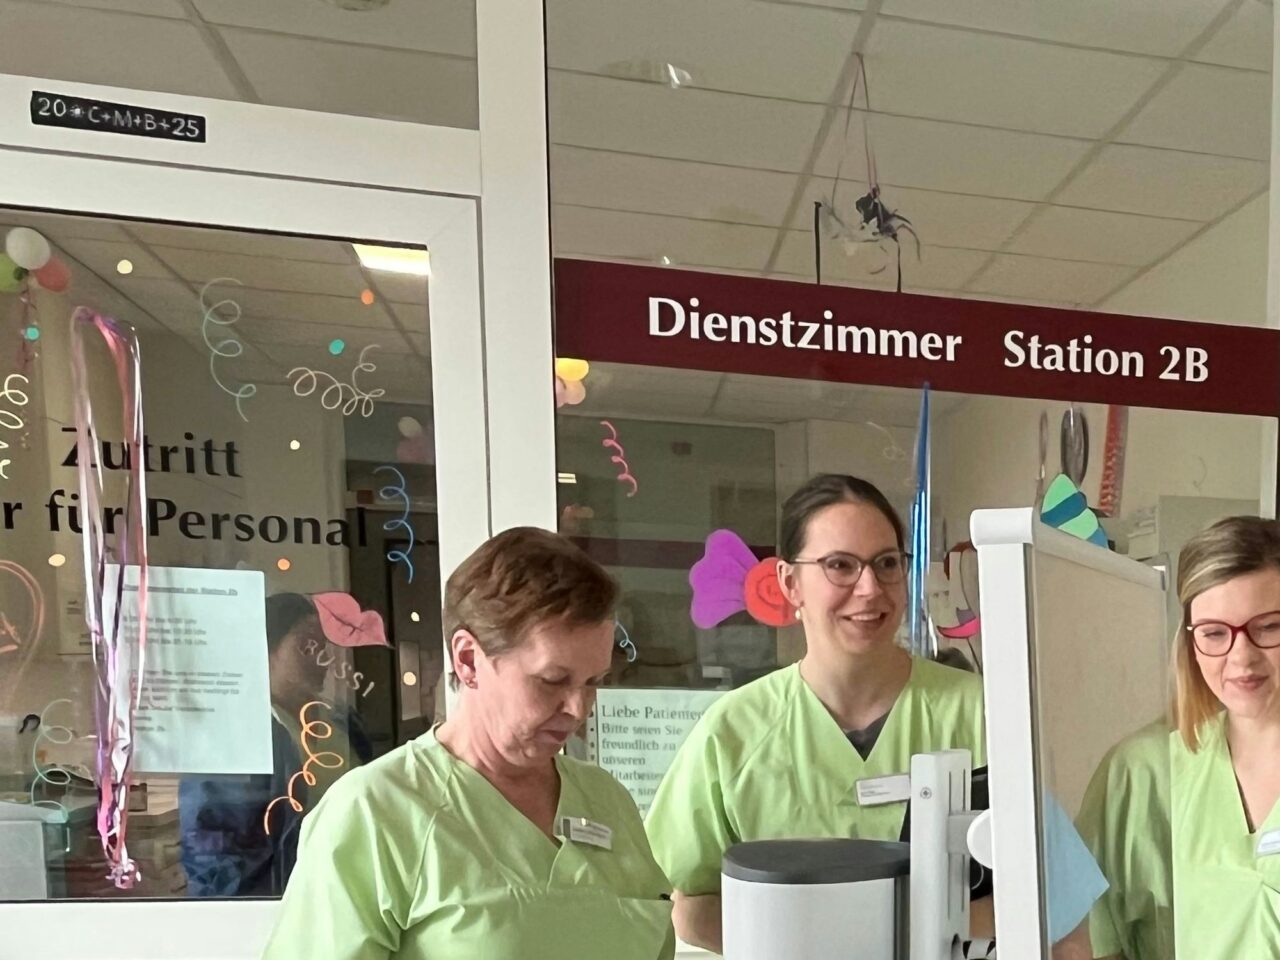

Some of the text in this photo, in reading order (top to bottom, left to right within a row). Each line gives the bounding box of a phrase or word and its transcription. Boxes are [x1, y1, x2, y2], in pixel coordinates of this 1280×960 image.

[648, 296, 1209, 383] Dienstzimmer Station 2B
[61, 427, 244, 478] Zutritt
[146, 497, 367, 548] Personal
[601, 704, 640, 719] Liebe
[601, 723, 629, 734] Bitte
[664, 725, 684, 736] Sie
[601, 738, 660, 751] freundlich
